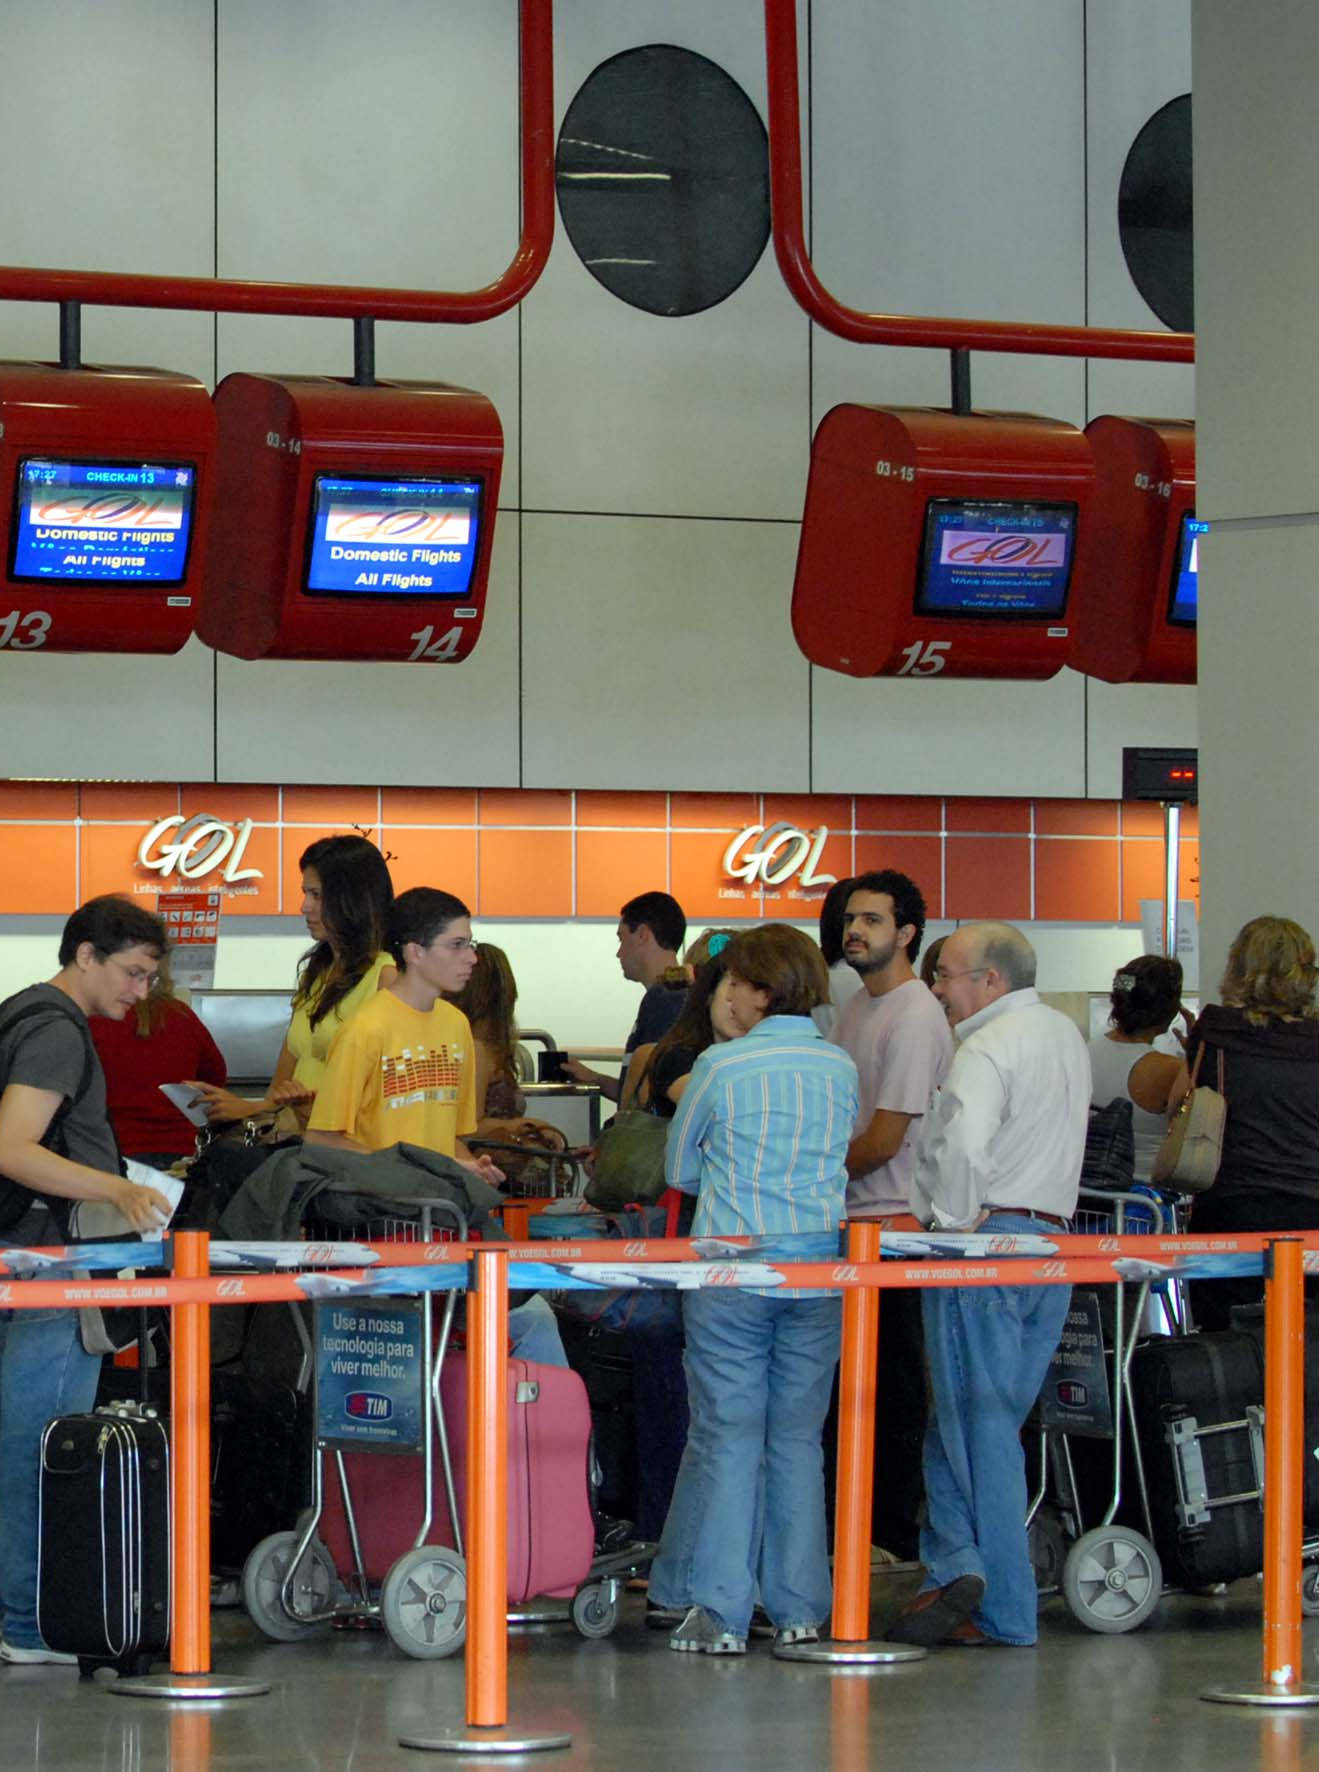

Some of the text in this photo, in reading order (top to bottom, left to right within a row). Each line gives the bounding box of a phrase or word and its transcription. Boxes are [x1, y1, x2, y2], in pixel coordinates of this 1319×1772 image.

[86, 471, 155, 484] CHECK-IN 13
[38, 493, 174, 526] GOL
[335, 508, 462, 542] GOL
[331, 546, 462, 566] Domestic Flights
[948, 535, 1059, 566] GOL
[355, 572, 433, 589] All Flights
[408, 624, 464, 662] 14
[897, 640, 953, 676] 15
[138, 813, 264, 882] GOL
[723, 820, 839, 888] GOL
[332, 1312, 404, 1334] Use a nossa
[323, 1335, 414, 1359] tecnologia para
[331, 1355, 407, 1379] viver melhor.
[365, 1397, 388, 1417] TIM
